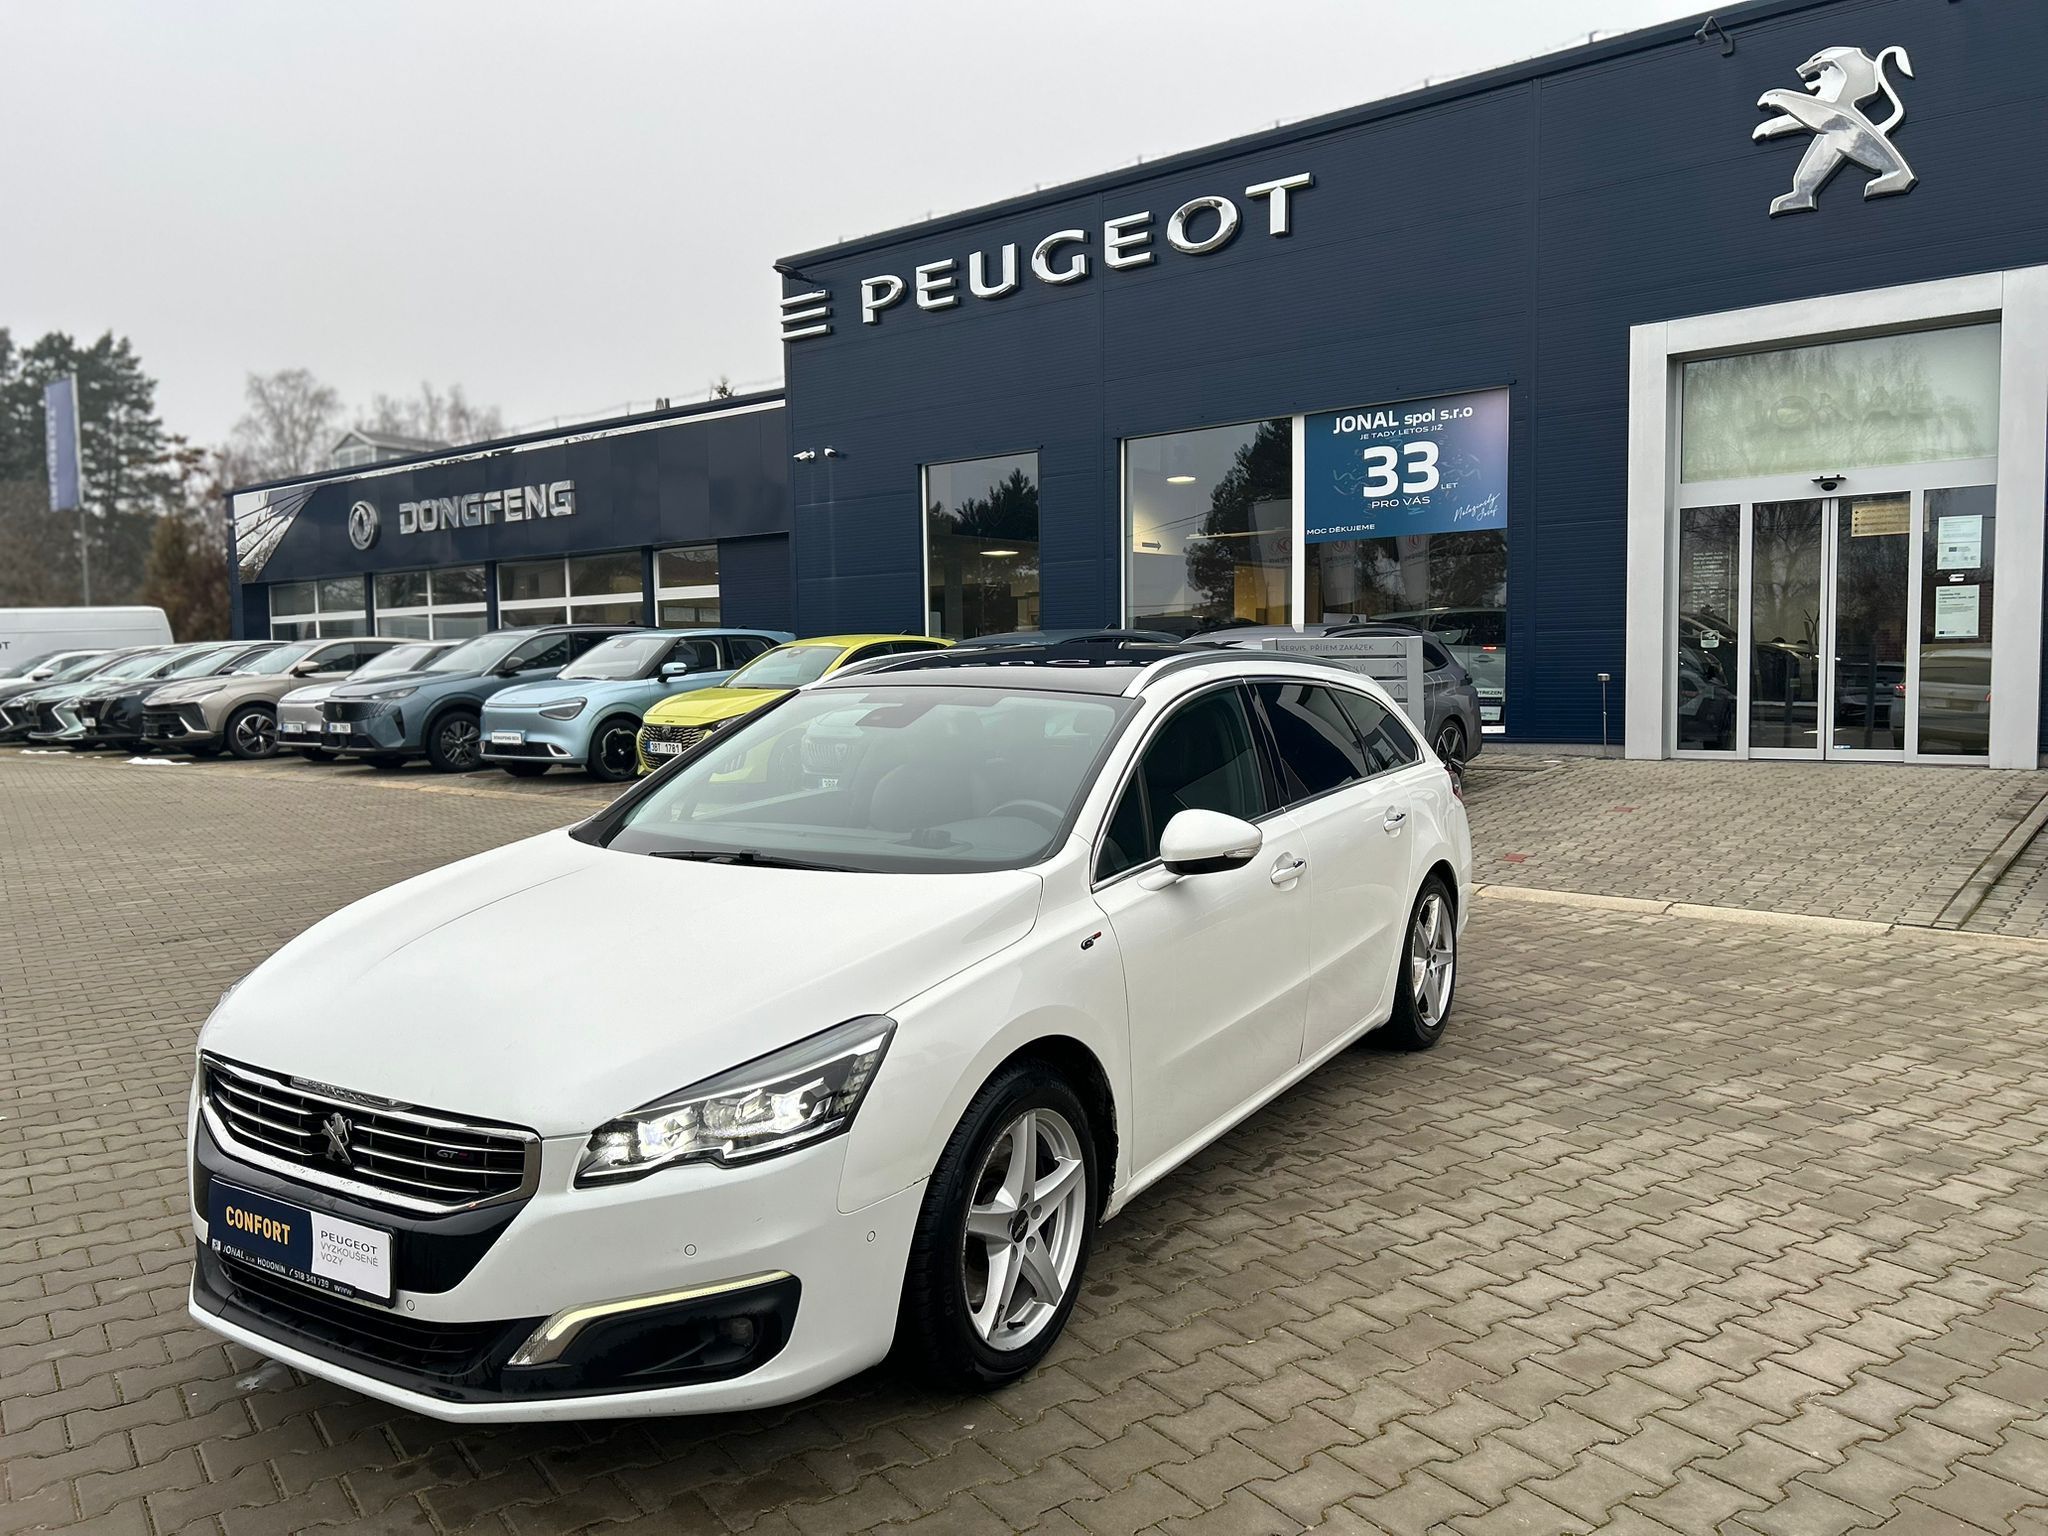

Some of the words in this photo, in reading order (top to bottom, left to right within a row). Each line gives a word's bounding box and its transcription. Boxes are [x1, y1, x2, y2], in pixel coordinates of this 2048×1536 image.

[860, 172, 1315, 325] PEUGEOT
[1333, 410, 1400, 435] JONAL
[1404, 408, 1436, 426] spol
[1440, 406, 1473, 421] s.r.o
[1359, 433, 1370, 441] JE
[1371, 429, 1396, 440] TADY
[1398, 425, 1429, 437] LETOS
[1430, 423, 1444, 433] JIŽ
[1363, 440, 1440, 498] 33
[1440, 482, 1459, 490] LET
[399, 479, 577, 535] DONGFENG
[1371, 499, 1400, 509] PRO
[1402, 495, 1431, 506] VÁS
[1306, 528, 1327, 536] MOC
[1329, 523, 1376, 534] DĚKUJEME
[1310, 643, 1338, 651] PŘÍJEM
[1339, 643, 1374, 651] ZAKÁZEK
[665, 743, 680, 753] 1781
[225, 1205, 291, 1246] CONFORT
[320, 1230, 378, 1255] PEUGEOT
[320, 1241, 379, 1267] VYZKOUŠENÉ
[222, 1244, 245, 1259] JONAL
[294, 1270, 305, 1281] 518
[320, 1251, 343, 1266] VOZY
